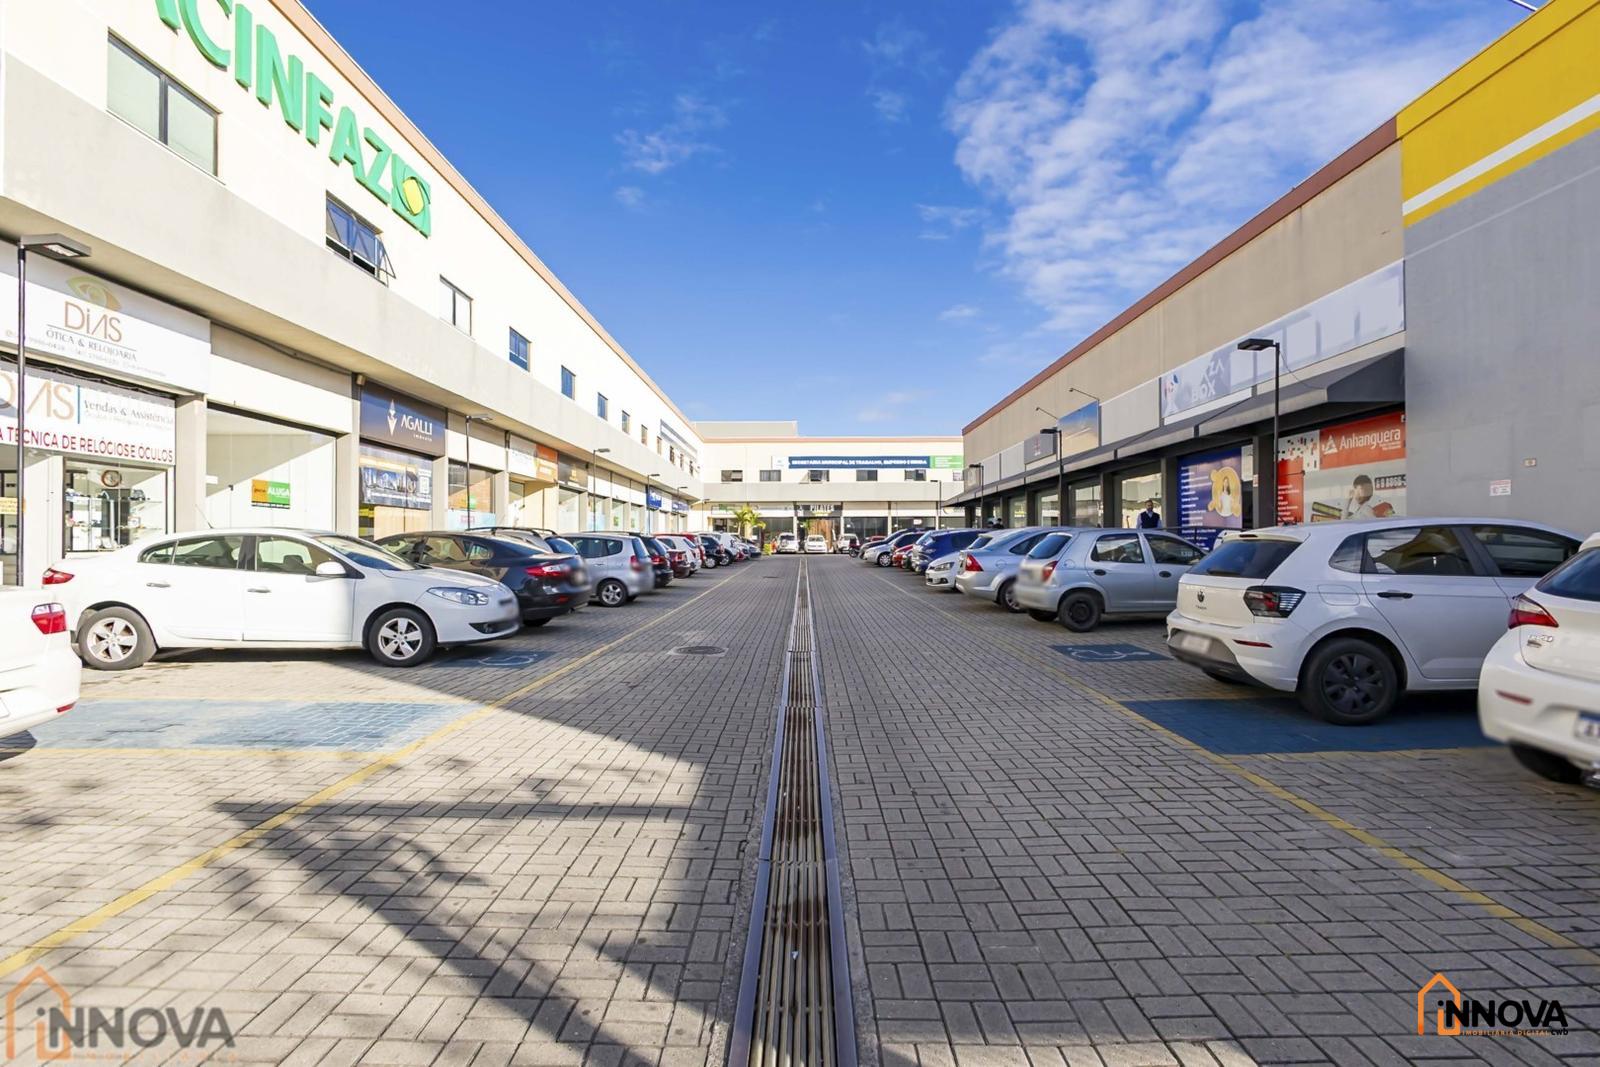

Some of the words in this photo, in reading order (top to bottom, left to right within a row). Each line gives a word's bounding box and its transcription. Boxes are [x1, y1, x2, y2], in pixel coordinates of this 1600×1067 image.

[155, 0, 393, 205] CINFAZ
[400, 414, 433, 436] AGALLI
[62, 435, 77, 450] DE
[1339, 428, 1401, 450] Anhanguera
